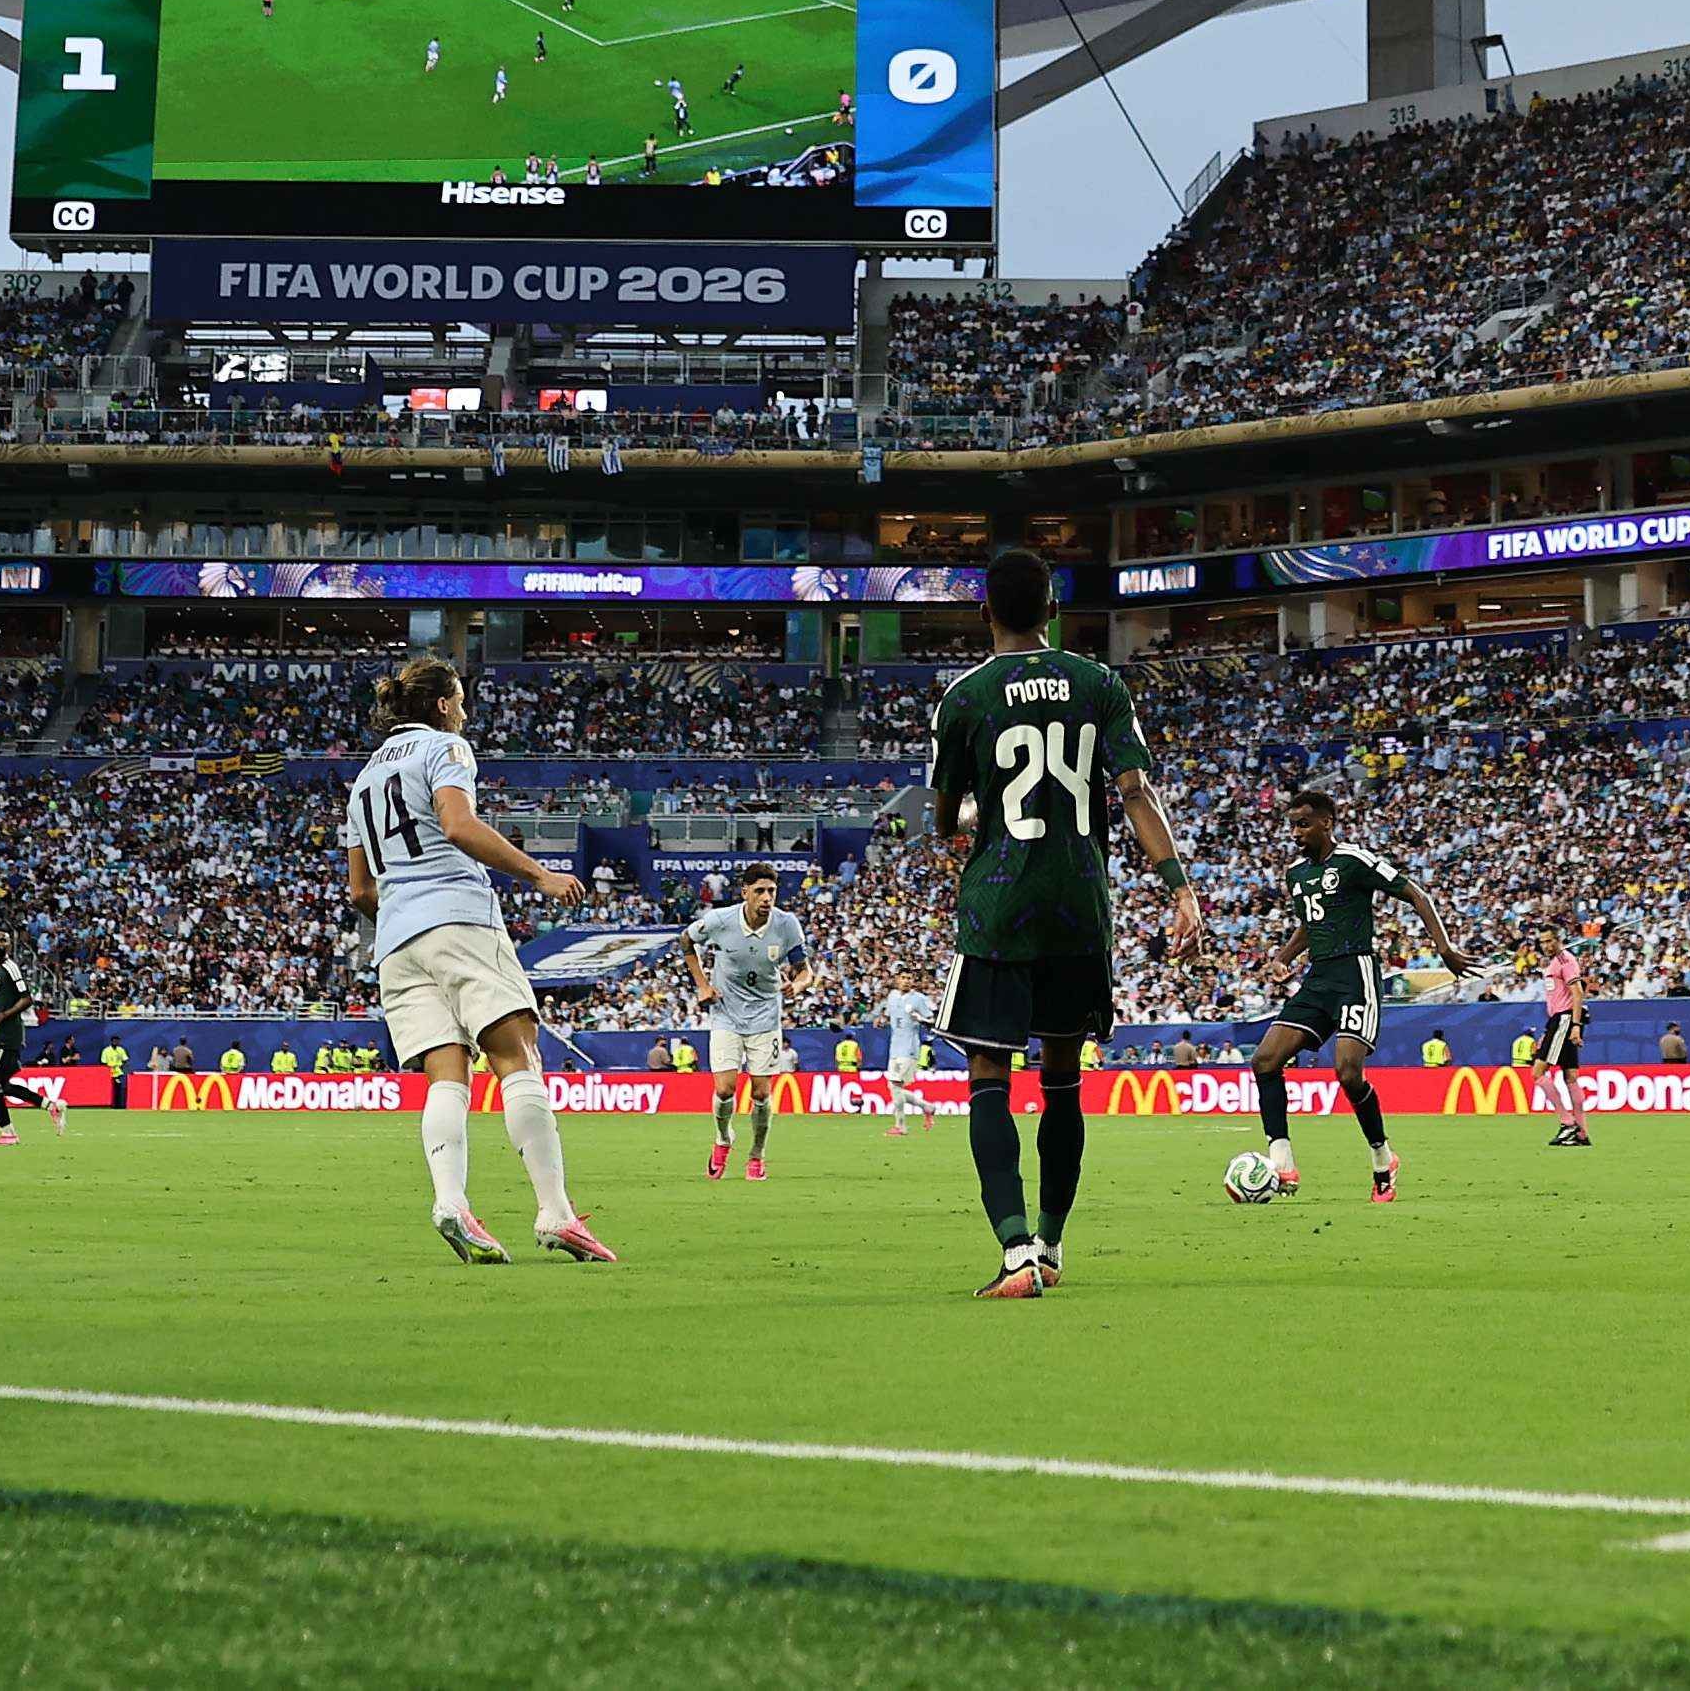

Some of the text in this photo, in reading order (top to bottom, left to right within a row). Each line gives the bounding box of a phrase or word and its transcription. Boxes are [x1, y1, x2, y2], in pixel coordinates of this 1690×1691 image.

[62, 36, 117, 91] 1
[888, 48, 957, 104] 0
[1389, 105, 1416, 125] 313
[441, 181, 565, 204] Hisense
[58, 207, 89, 226] CC
[909, 214, 941, 233] CC
[4, 274, 41, 293] 309
[218, 262, 787, 304] FIFA WORLD CUP 2026
[1487, 526, 1543, 560] FIFA
[1545, 520, 1639, 556] WORLD
[523, 572, 644, 597] #FIFAWorldCup
[1118, 564, 1197, 595] MIAMI
[1005, 678, 1071, 708] MOTEB
[995, 721, 1097, 840] 24
[359, 772, 425, 876] 14
[538, 859, 574, 871] 026
[652, 859, 680, 872] FIFA
[768, 859, 809, 872] 026
[1303, 892, 1326, 923] 15
[746, 971, 758, 987] 8
[1339, 1004, 1364, 1031] 15
[771, 1037, 780, 1061] 8
[237, 1075, 402, 1111] McDonald's
[547, 1074, 664, 1114] Delivery
